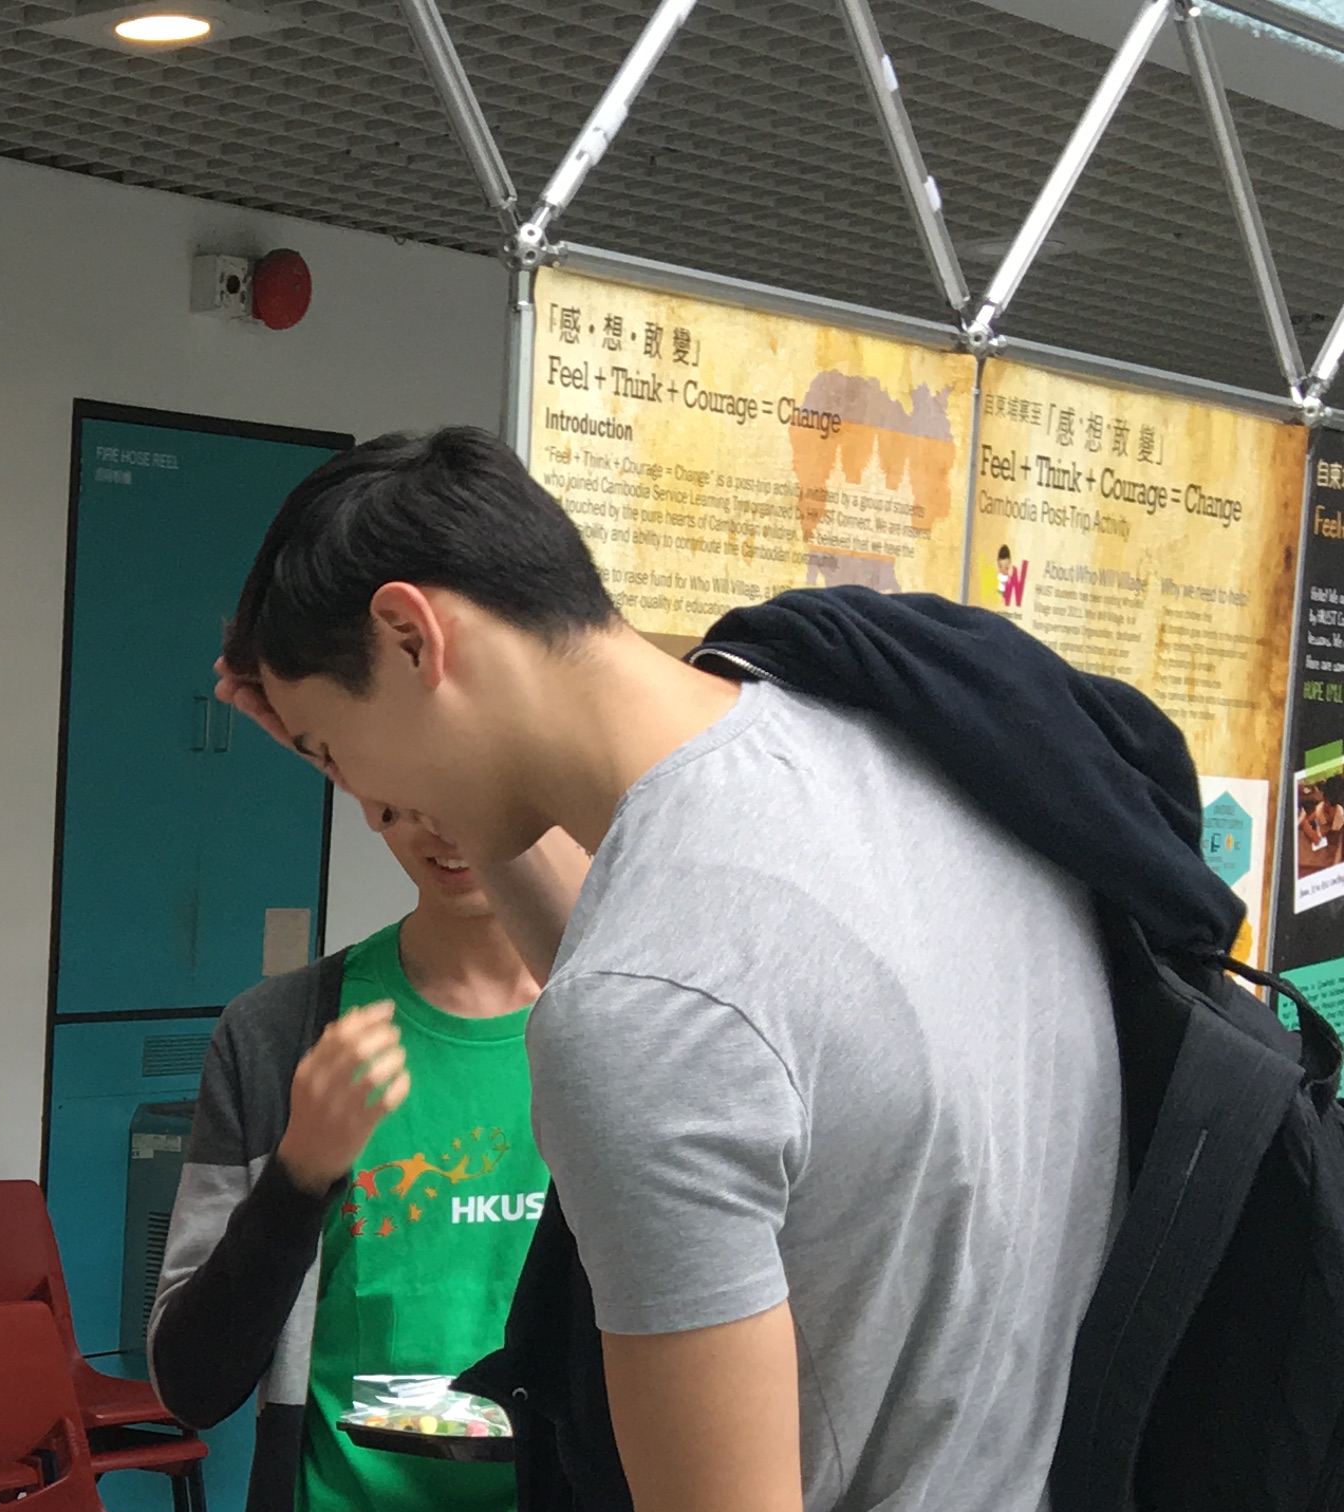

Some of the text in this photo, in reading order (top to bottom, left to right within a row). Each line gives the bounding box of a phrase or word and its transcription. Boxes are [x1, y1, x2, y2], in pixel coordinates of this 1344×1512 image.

[547, 355, 589, 391] Feel
[611, 366, 662, 403] Think
[683, 380, 759, 425] Courage
[777, 397, 842, 440] Change
[545, 407, 633, 441] Introduction
[96, 446, 179, 470] FIRE HOSE REEL
[622, 456, 663, 482] Courage
[544, 472, 565, 486] who
[600, 477, 651, 500] Cambodia
[980, 444, 1016, 483] Feel
[1036, 454, 1082, 495] Think
[1100, 467, 1167, 515] Courage
[1184, 483, 1242, 528] Change
[979, 490, 1132, 542] Cambodia Post-Trip Activity
[1043, 561, 1074, 582] About
[452, 1192, 545, 1225] HKUS
